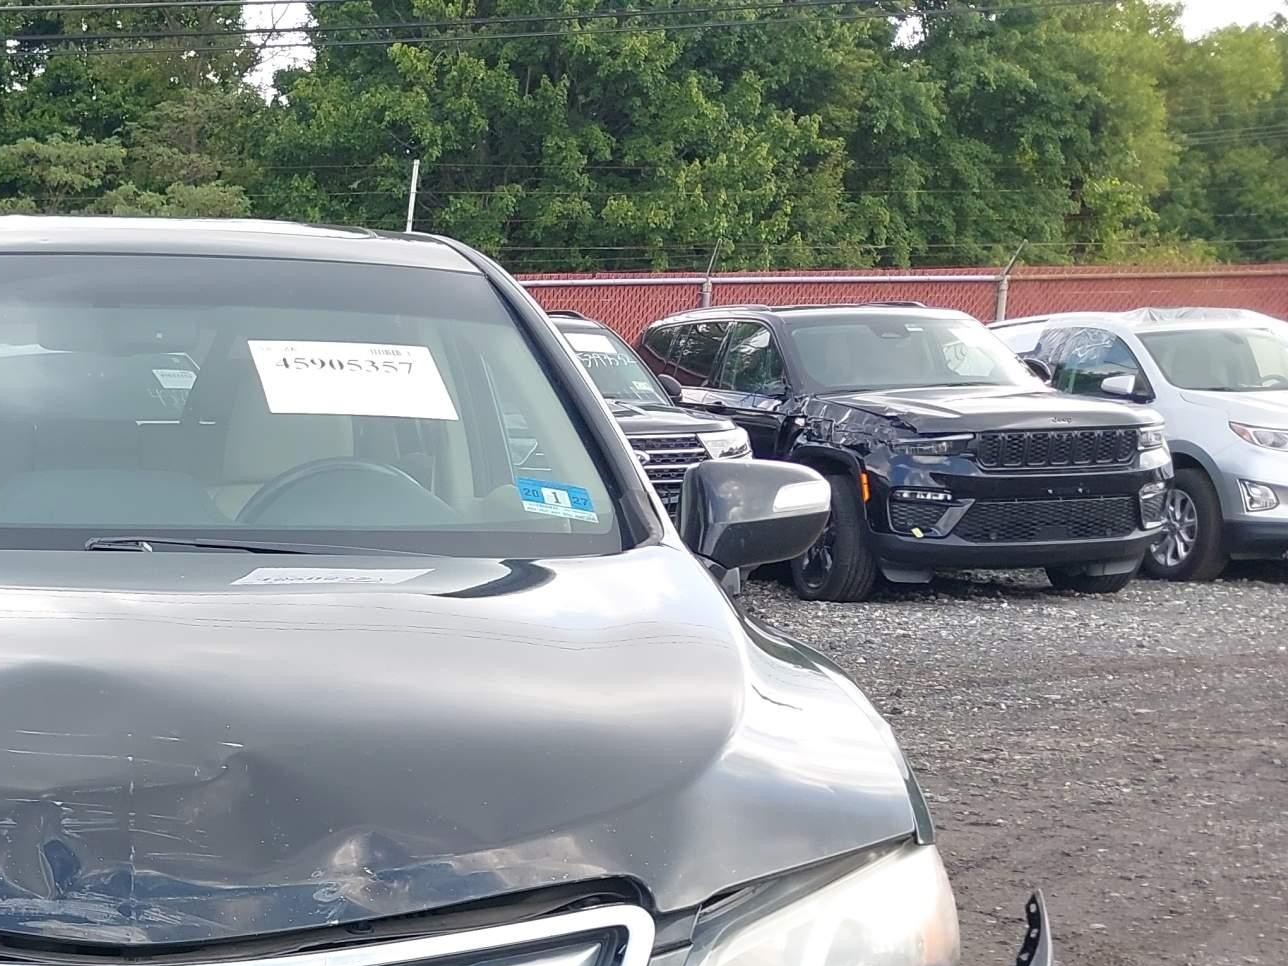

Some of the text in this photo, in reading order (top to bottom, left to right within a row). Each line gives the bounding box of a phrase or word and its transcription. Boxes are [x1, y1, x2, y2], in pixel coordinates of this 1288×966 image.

[275, 357, 414, 375] 45905357
[523, 487, 588, 506] 20 1 27
